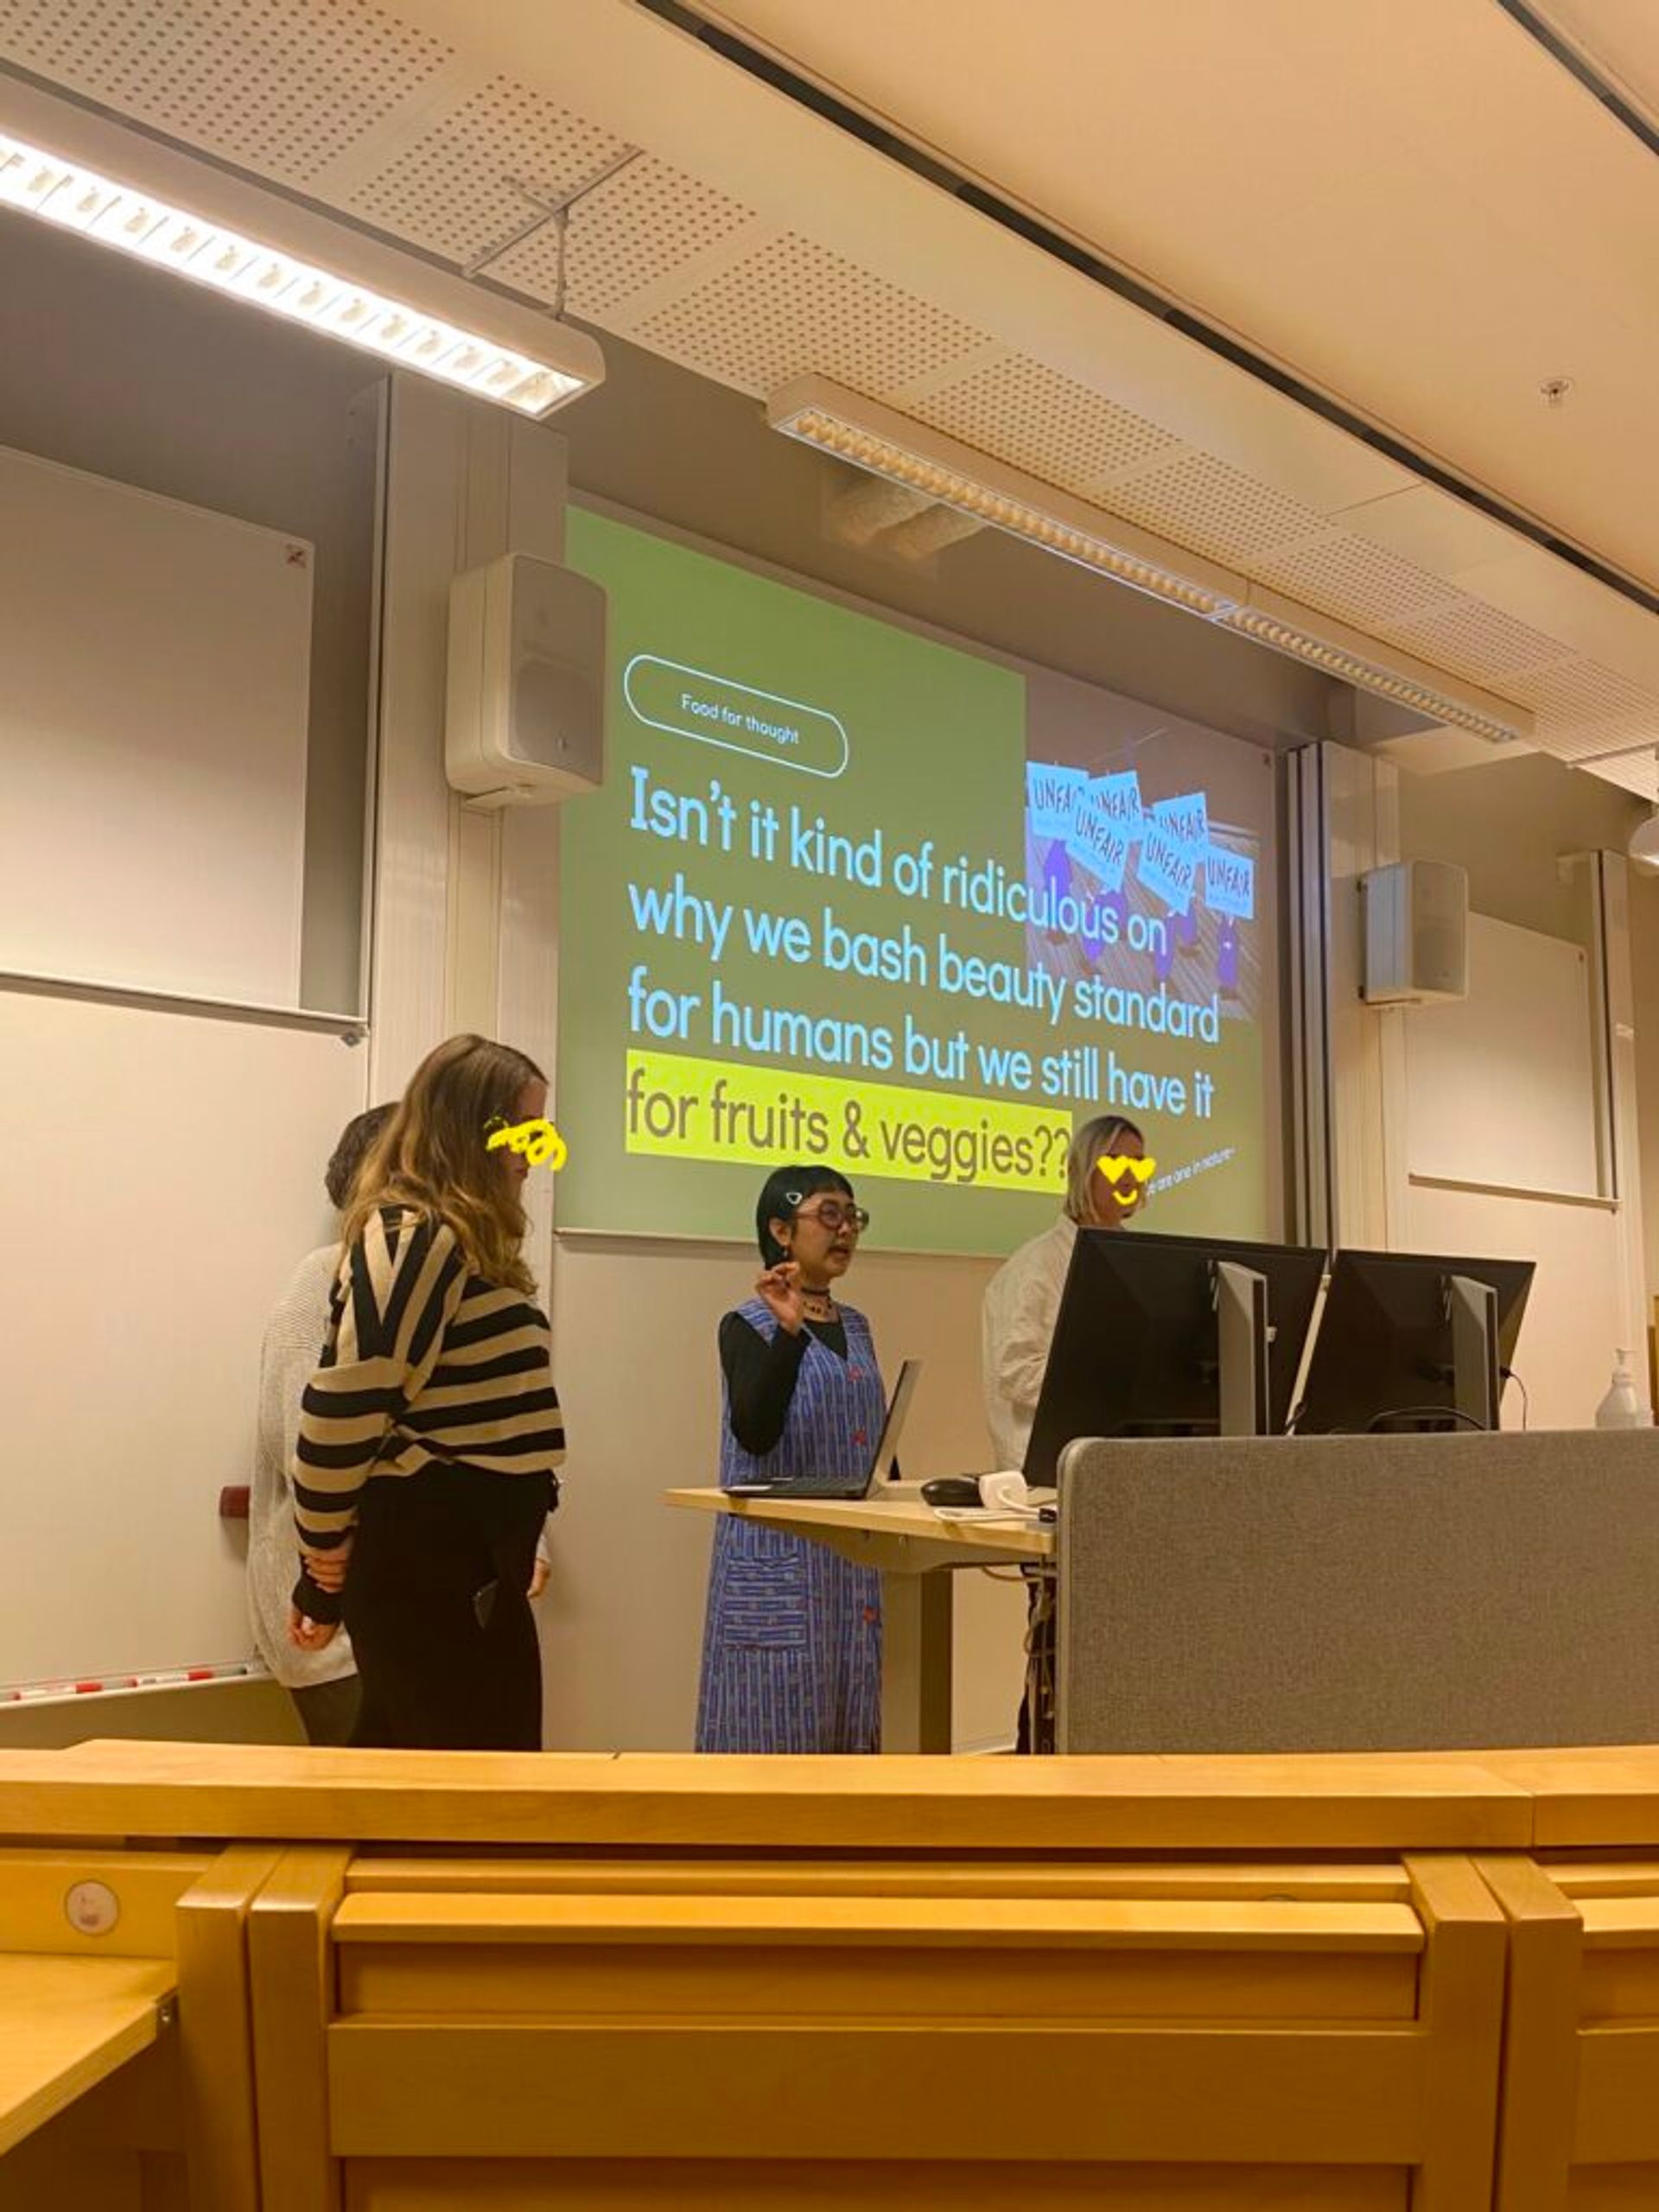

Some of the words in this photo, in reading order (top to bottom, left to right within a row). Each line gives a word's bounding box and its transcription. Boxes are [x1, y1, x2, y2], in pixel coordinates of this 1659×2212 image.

[681, 694, 718, 719] Food
[721, 706, 742, 726] for
[746, 716, 799, 744] thought
[750, 800, 779, 861] it
[791, 806, 882, 887] kind
[893, 842, 933, 899] of
[944, 856, 1119, 943] ridiculous
[1128, 914, 1166, 956] on
[1076, 805, 1124, 865] UNFAIR
[1147, 832, 1192, 891] UNFAIR
[1207, 855, 1250, 899] UNFAIR
[628, 873, 733, 962] why
[743, 908, 811, 963] we
[824, 907, 926, 986] bash
[939, 933, 1066, 1026] beauty
[1074, 975, 1218, 1043] standard
[628, 966, 701, 1039] for
[712, 980, 893, 1070] humans
[906, 1014, 969, 1080] but
[977, 1045, 1032, 1090] we
[1041, 1046, 1098, 1101] still
[1109, 1051, 1186, 1115] have
[1193, 1071, 1214, 1118] it
[628, 1068, 698, 1139] for
[711, 1079, 830, 1154] fruits
[842, 1100, 869, 1160] &
[880, 1118, 1071, 1182] veggies??
